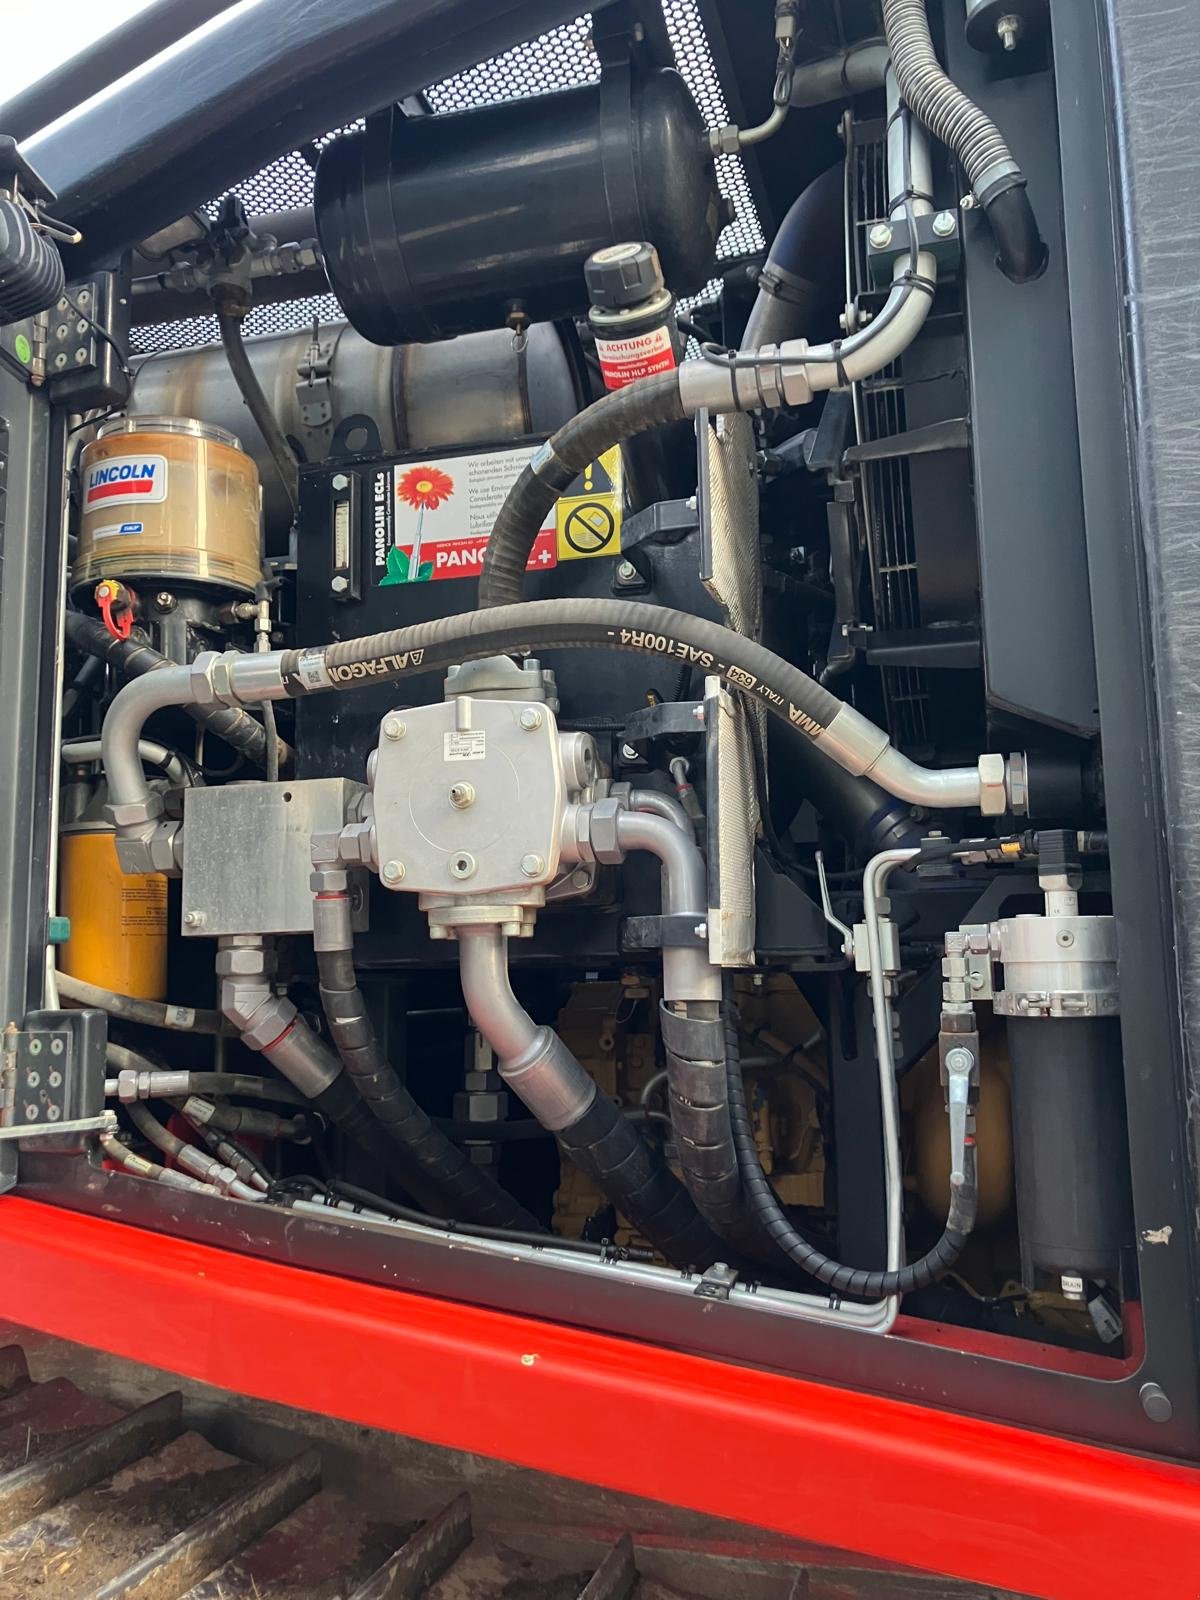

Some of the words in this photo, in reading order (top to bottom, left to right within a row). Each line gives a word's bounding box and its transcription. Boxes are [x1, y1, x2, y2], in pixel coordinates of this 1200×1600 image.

[606, 338, 652, 352] ACHTUNG
[647, 360, 670, 373] SYNTH
[89, 464, 156, 488] LINCOLN
[374, 472, 385, 502] ECLs
[374, 506, 386, 566] PANOLIN
[620, 628, 714, 668] SAE100R4
[729, 667, 754, 687] 634
[757, 685, 784, 706] ITALY
